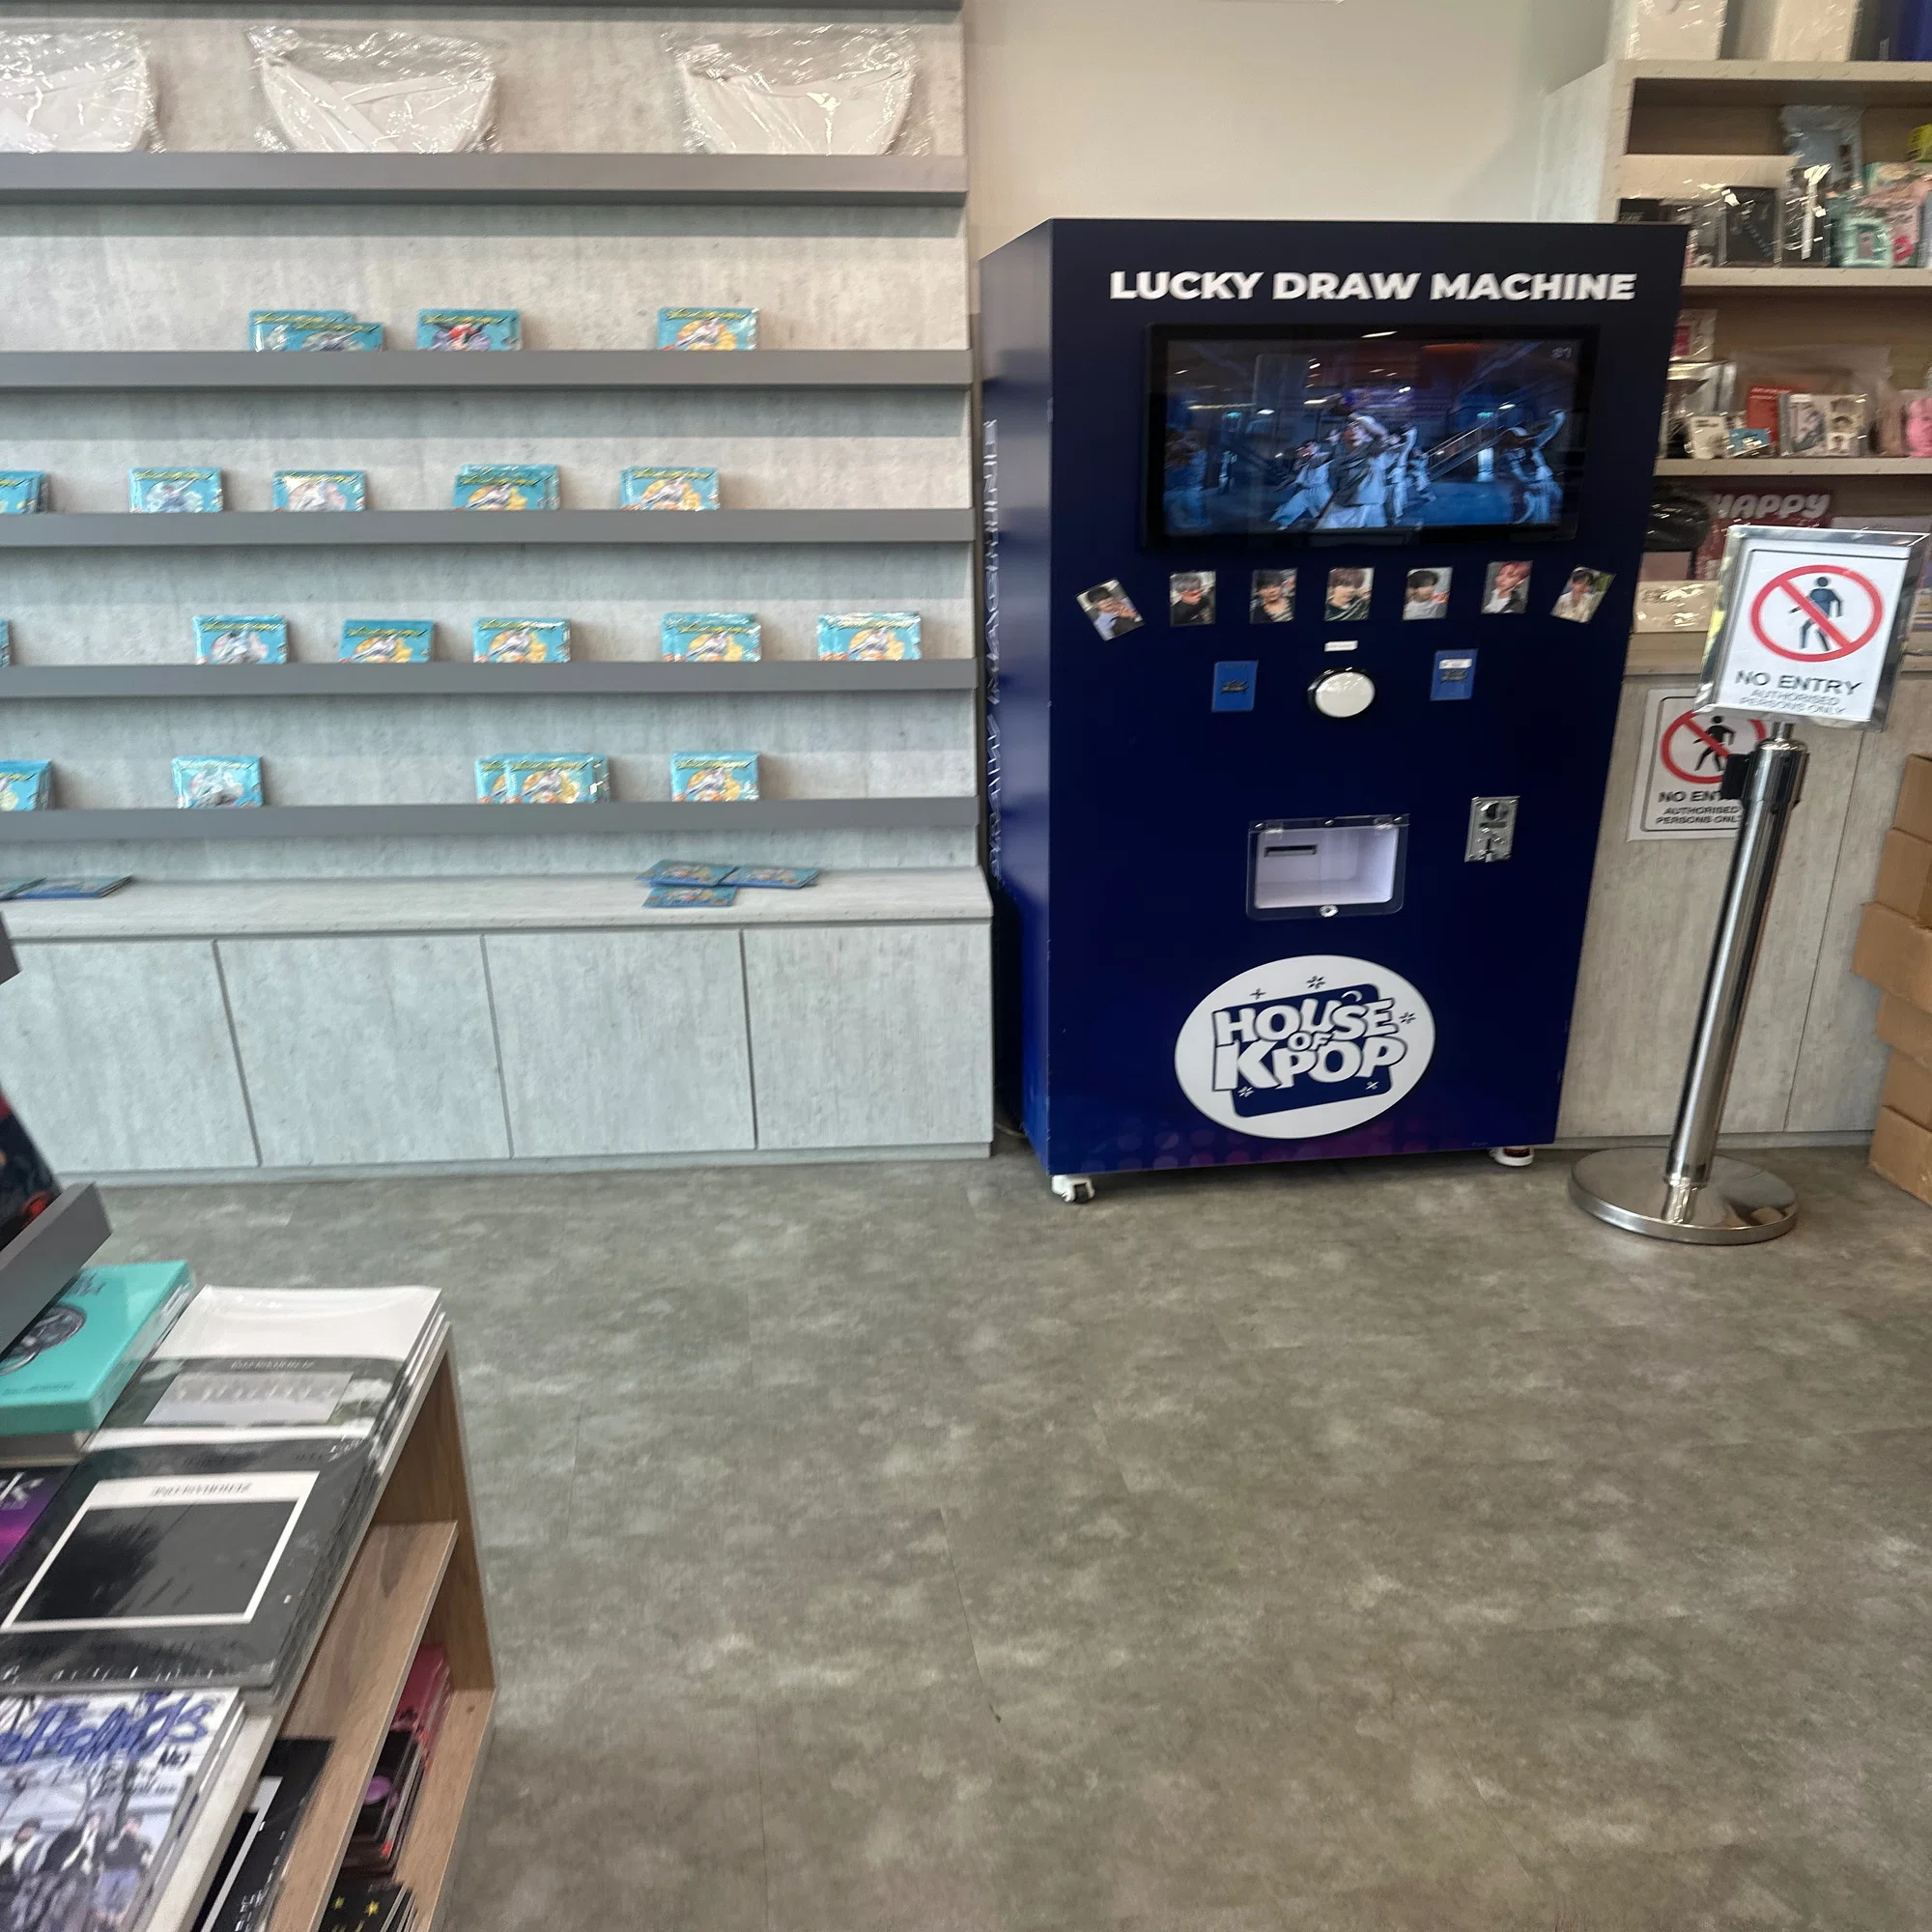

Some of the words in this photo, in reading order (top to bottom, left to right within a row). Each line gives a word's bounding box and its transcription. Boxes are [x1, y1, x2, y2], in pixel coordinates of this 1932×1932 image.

[1110, 270, 1264, 300] LUCKY
[1272, 271, 1422, 300] DRAW
[1430, 272, 1637, 301] MACHINE
[1735, 669, 1771, 686] NO
[1777, 674, 1863, 696] ENTRY
[1749, 689, 1841, 706] AUTHORISED
[1658, 790, 1688, 803] NO
[1656, 815, 1712, 825] PERSONS
[1211, 997, 1400, 1046] HOUSE
[1287, 1031, 1335, 1052] OF
[1211, 1036, 1408, 1092] KPOP
